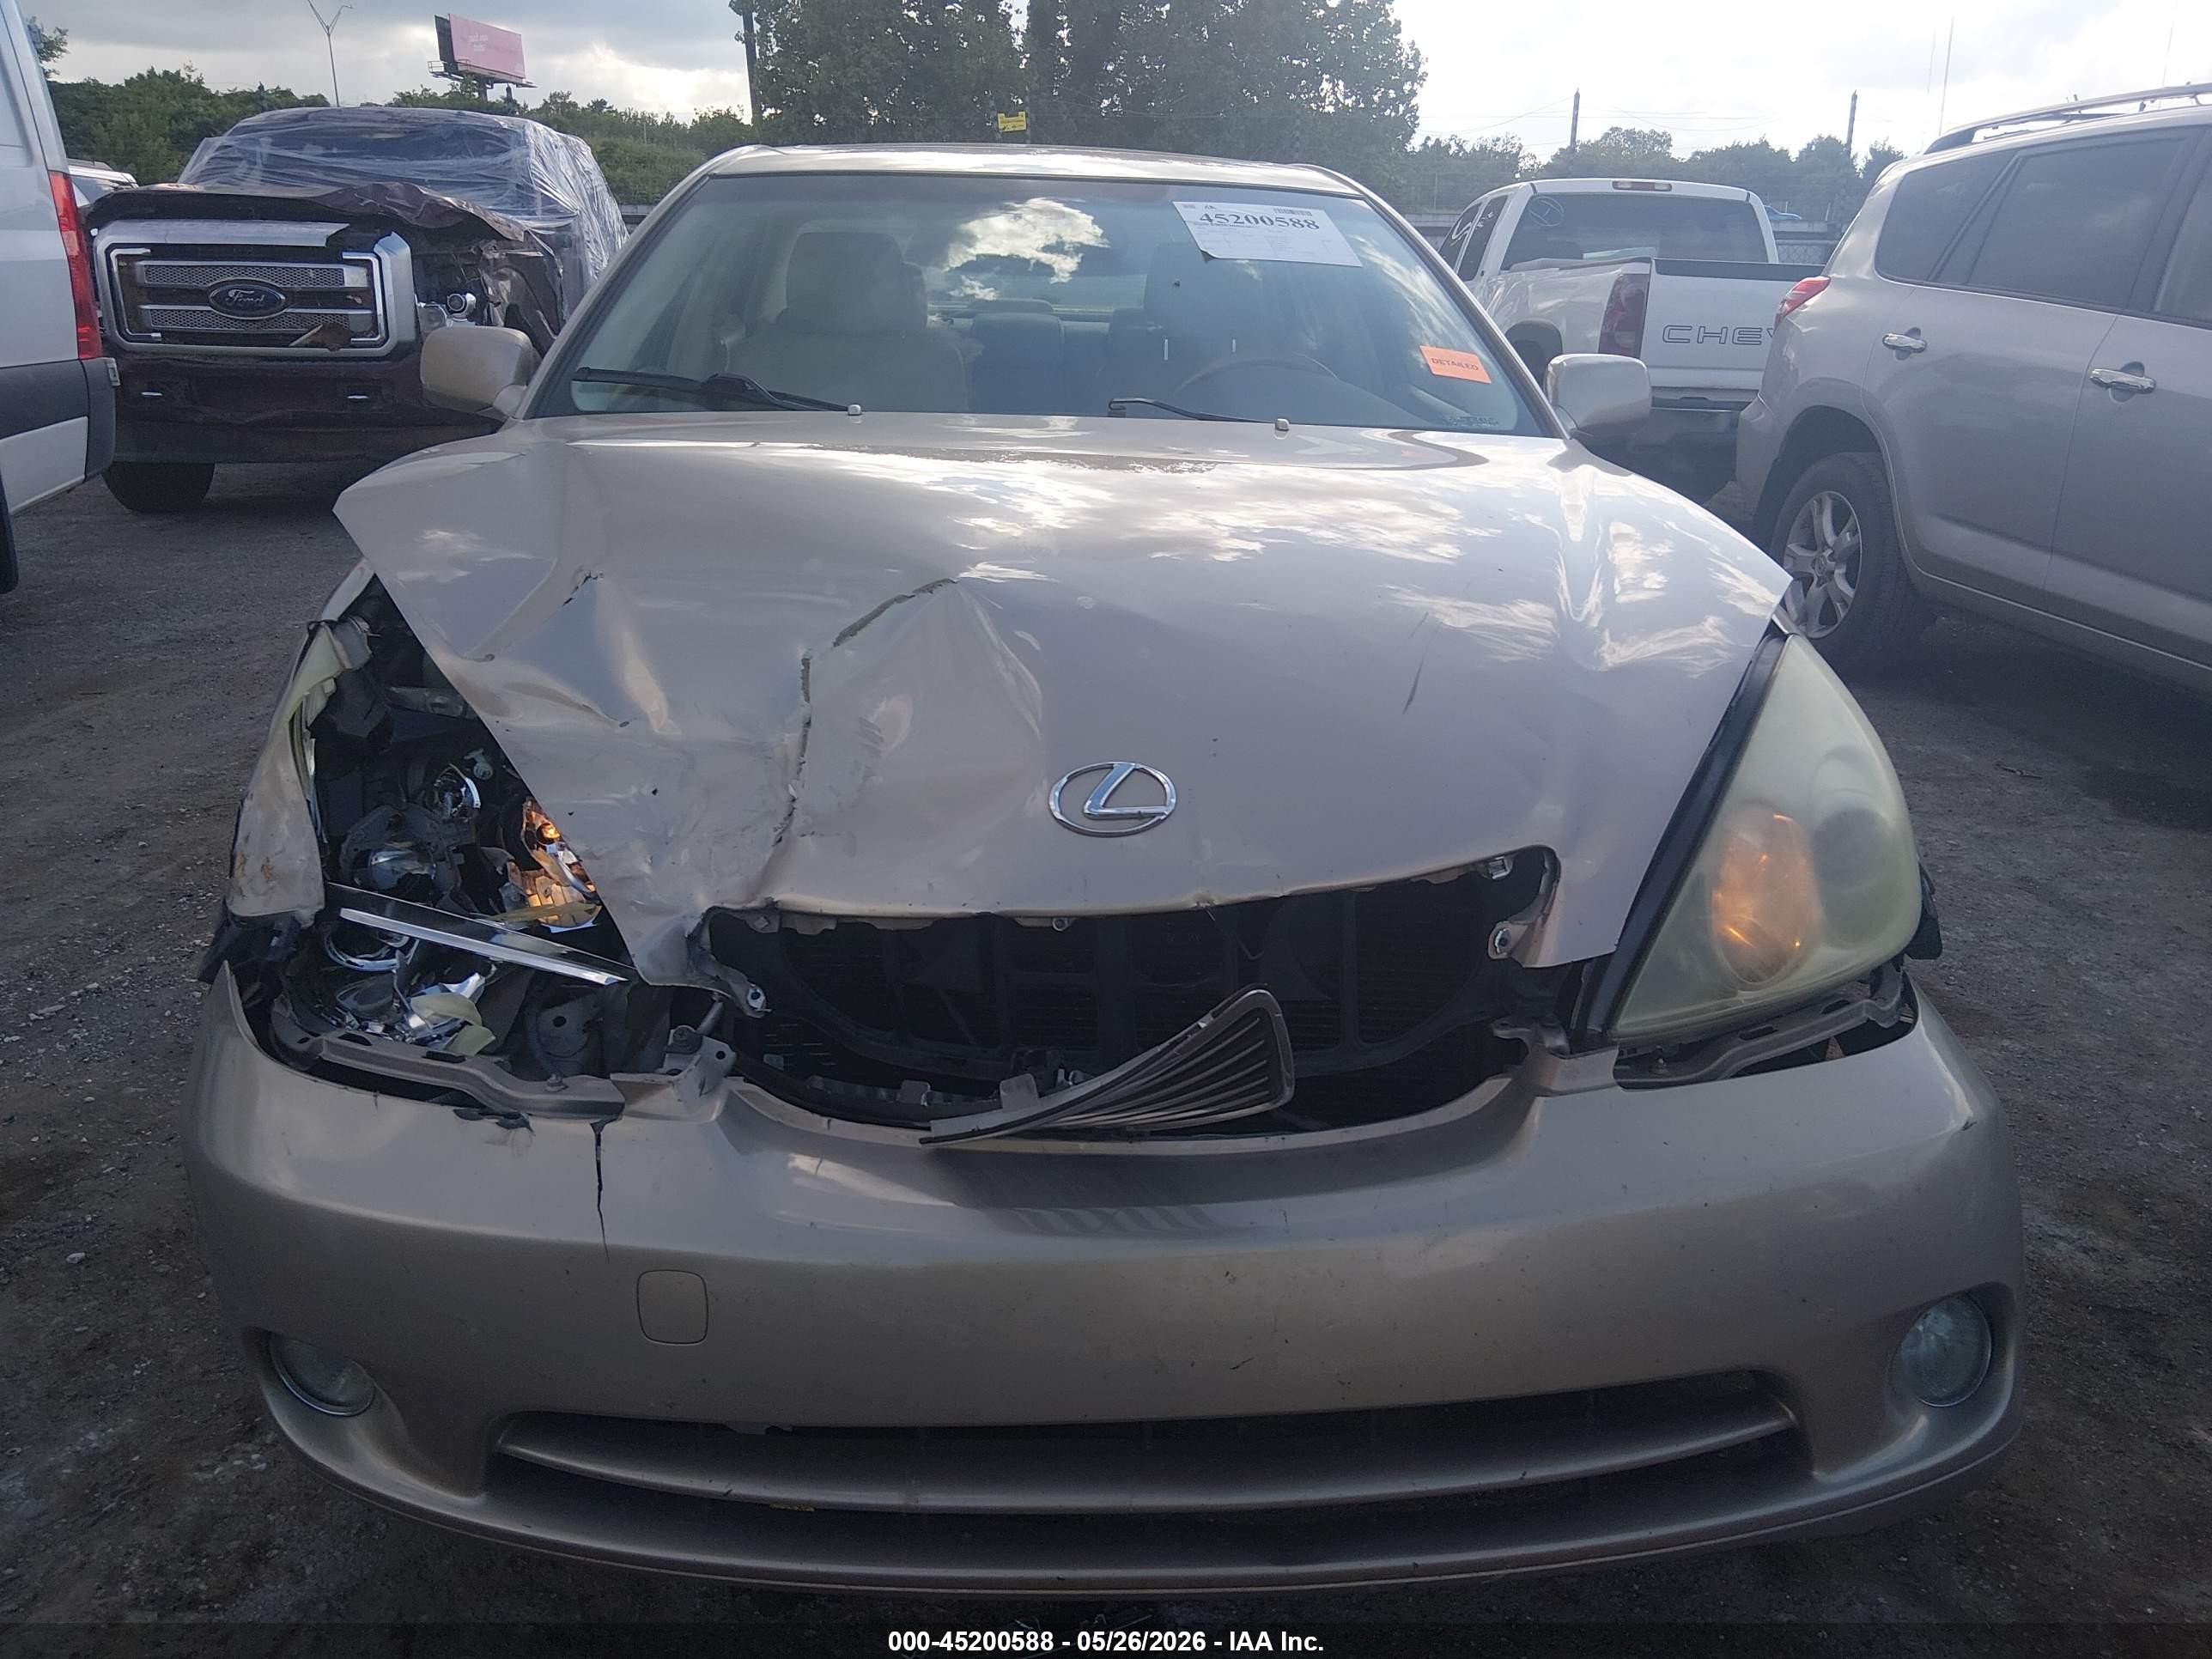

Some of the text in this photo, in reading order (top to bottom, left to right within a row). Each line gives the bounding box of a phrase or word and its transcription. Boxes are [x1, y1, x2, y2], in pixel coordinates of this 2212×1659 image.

[1200, 213, 1320, 230] 45200588
[225, 289, 265, 305] Ford
[1431, 357, 1479, 371] DETAILED
